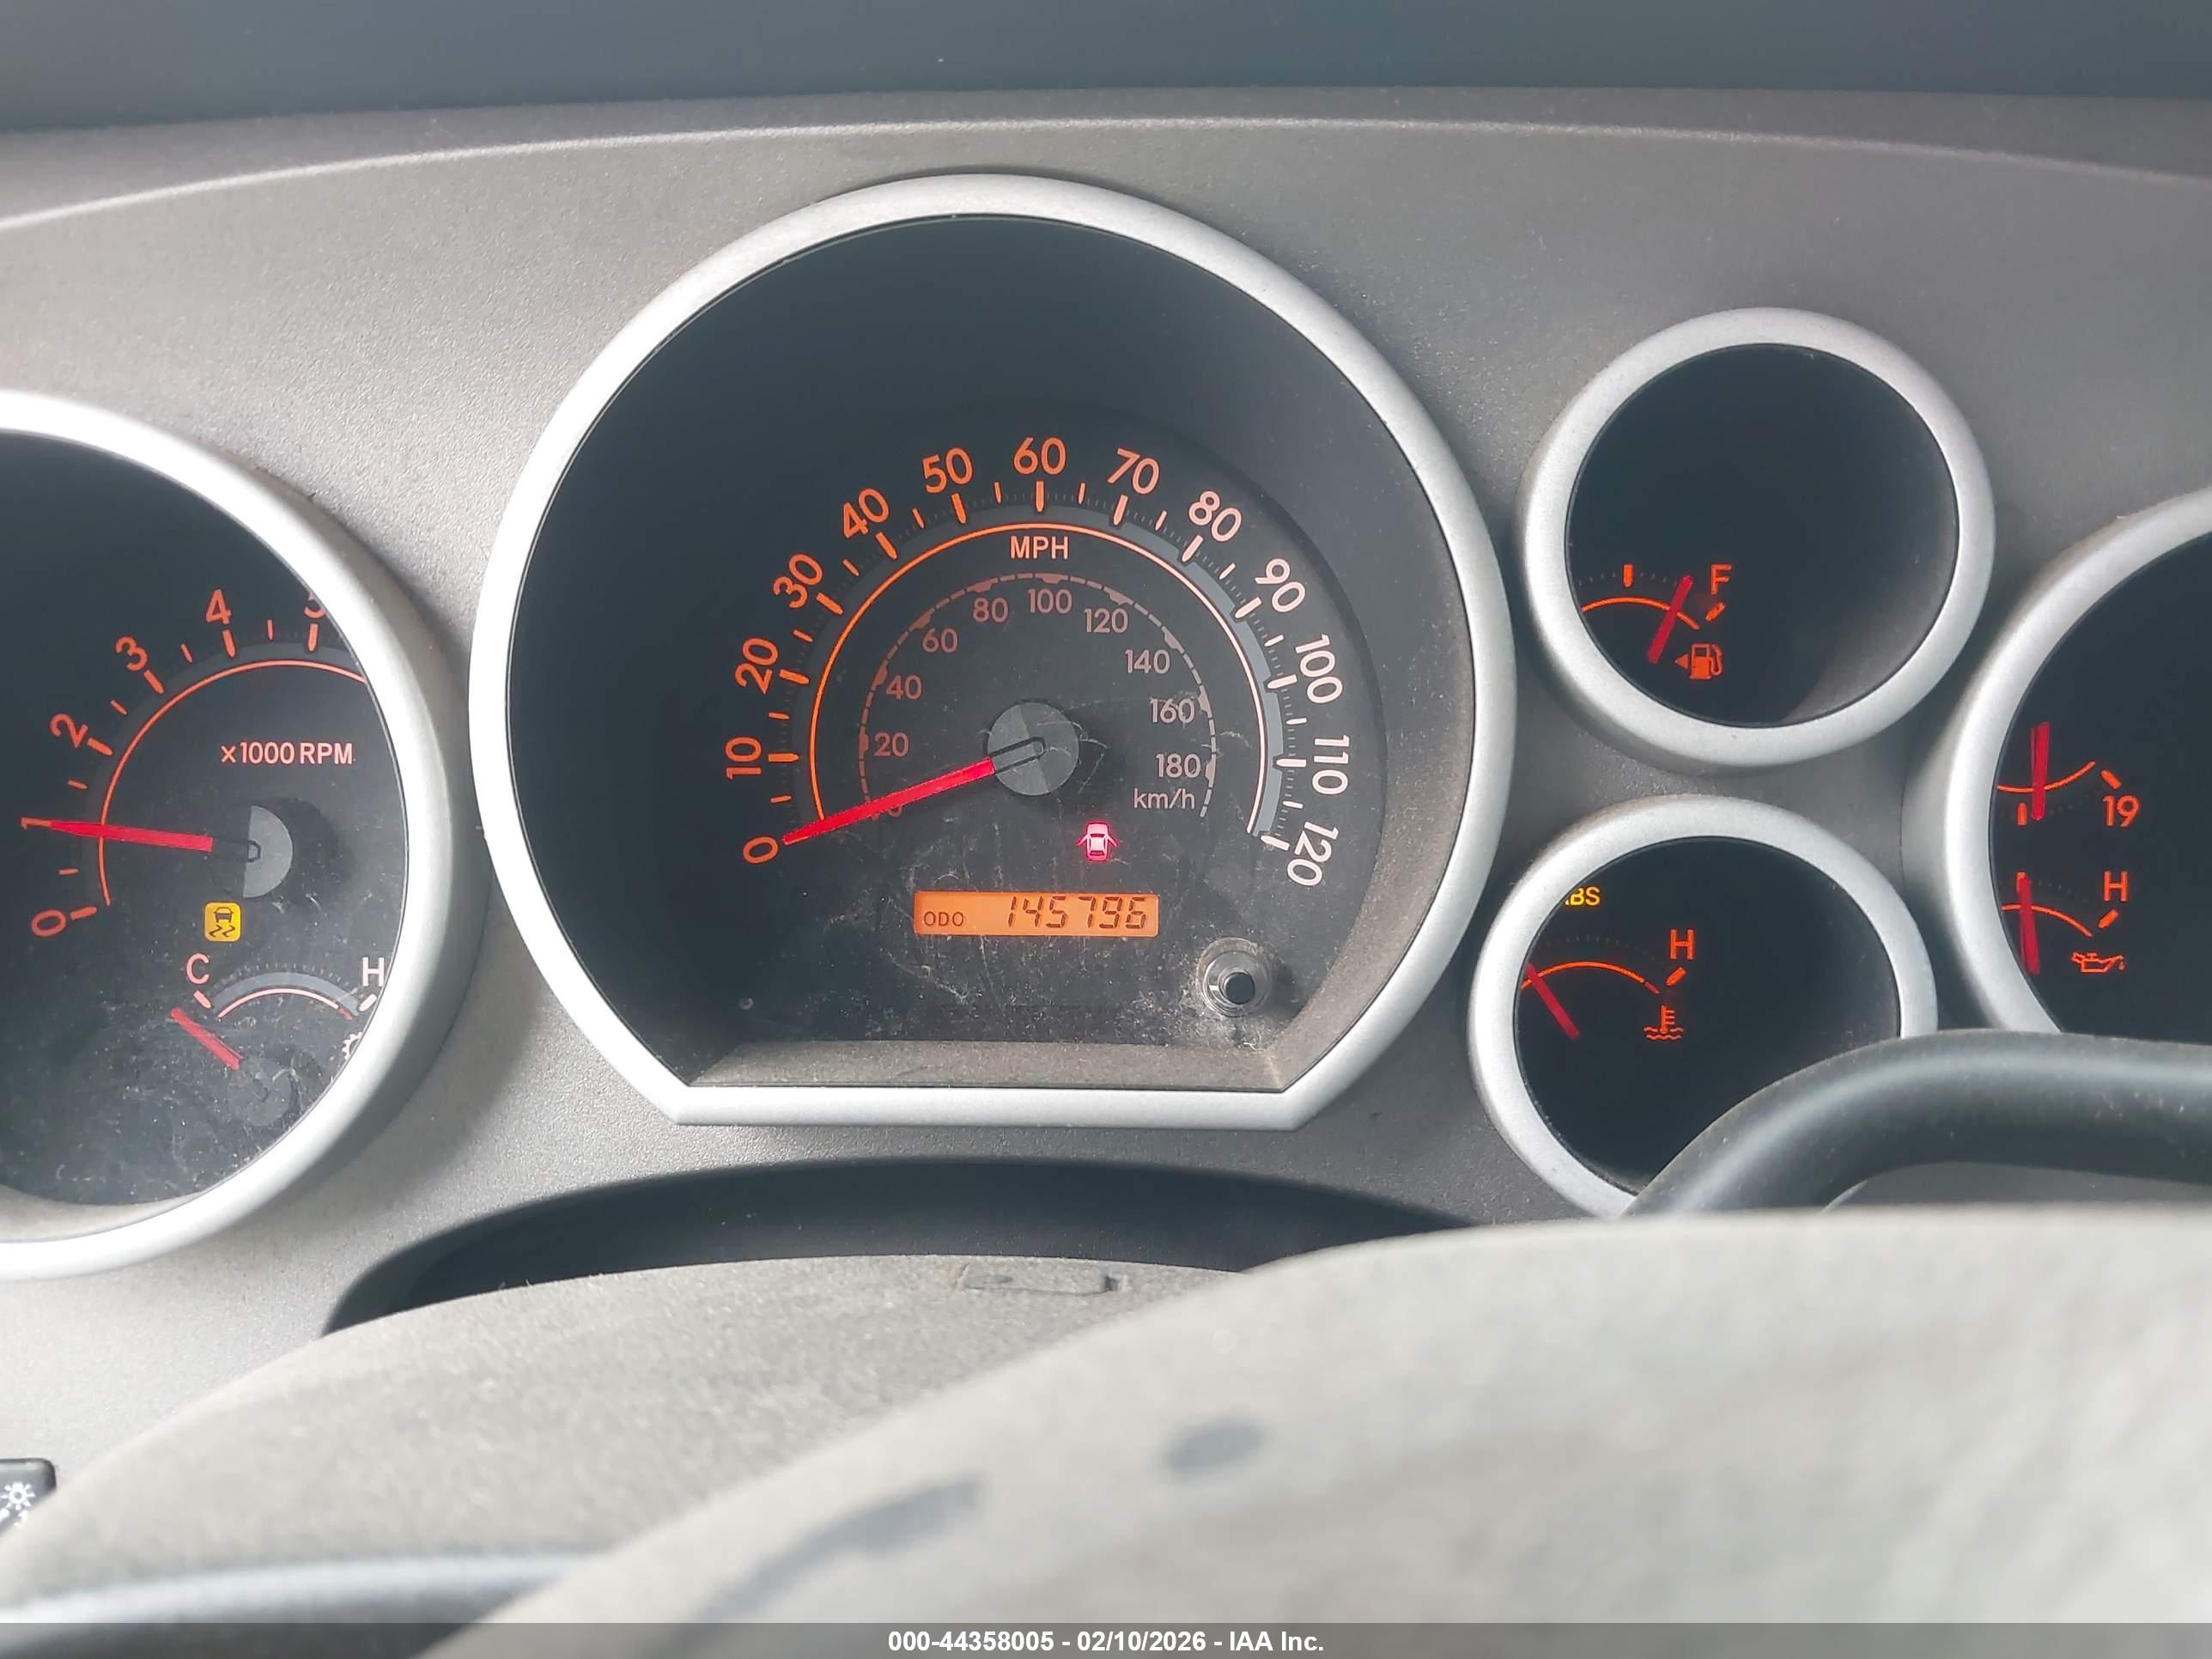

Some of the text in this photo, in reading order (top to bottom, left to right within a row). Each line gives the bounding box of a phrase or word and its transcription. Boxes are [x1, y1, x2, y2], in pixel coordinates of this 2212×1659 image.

[922, 447, 974, 494] 50
[1013, 438, 1066, 475] 60
[1108, 447, 1160, 494] 70
[842, 489, 890, 538] 40
[1188, 491, 1242, 542] 80
[1010, 536, 1069, 559] MPH
[773, 554, 823, 609] 30
[1255, 558, 1306, 612] 90
[1710, 564, 1732, 595] F
[205, 589, 232, 624] 4
[972, 597, 1009, 623] 80
[1028, 589, 1073, 614] 100
[1085, 609, 1128, 634] 120
[115, 636, 147, 671] 3
[922, 627, 958, 653] 60
[734, 637, 779, 694] 20
[1126, 649, 1170, 674] 140
[1295, 634, 1343, 703] 100
[885, 675, 922, 700] 40
[1151, 699, 1195, 724] 160
[50, 714, 88, 748] 2
[874, 732, 909, 757] 20
[222, 742, 353, 763] x1000 RPM
[725, 737, 763, 780] 10
[1156, 754, 1201, 779] 180
[1312, 734, 1351, 796] 110
[1133, 788, 1195, 810] km/h
[2103, 795, 2140, 827] 19
[743, 836, 779, 863] 0
[1287, 821, 1340, 886] 120
[1565, 886, 1601, 906] BS
[2104, 871, 2128, 902] H
[31, 909, 66, 937] 0
[923, 896, 1146, 928] ODO 145796
[1669, 929, 1694, 959] H
[185, 953, 210, 985] C
[362, 957, 385, 987] H
